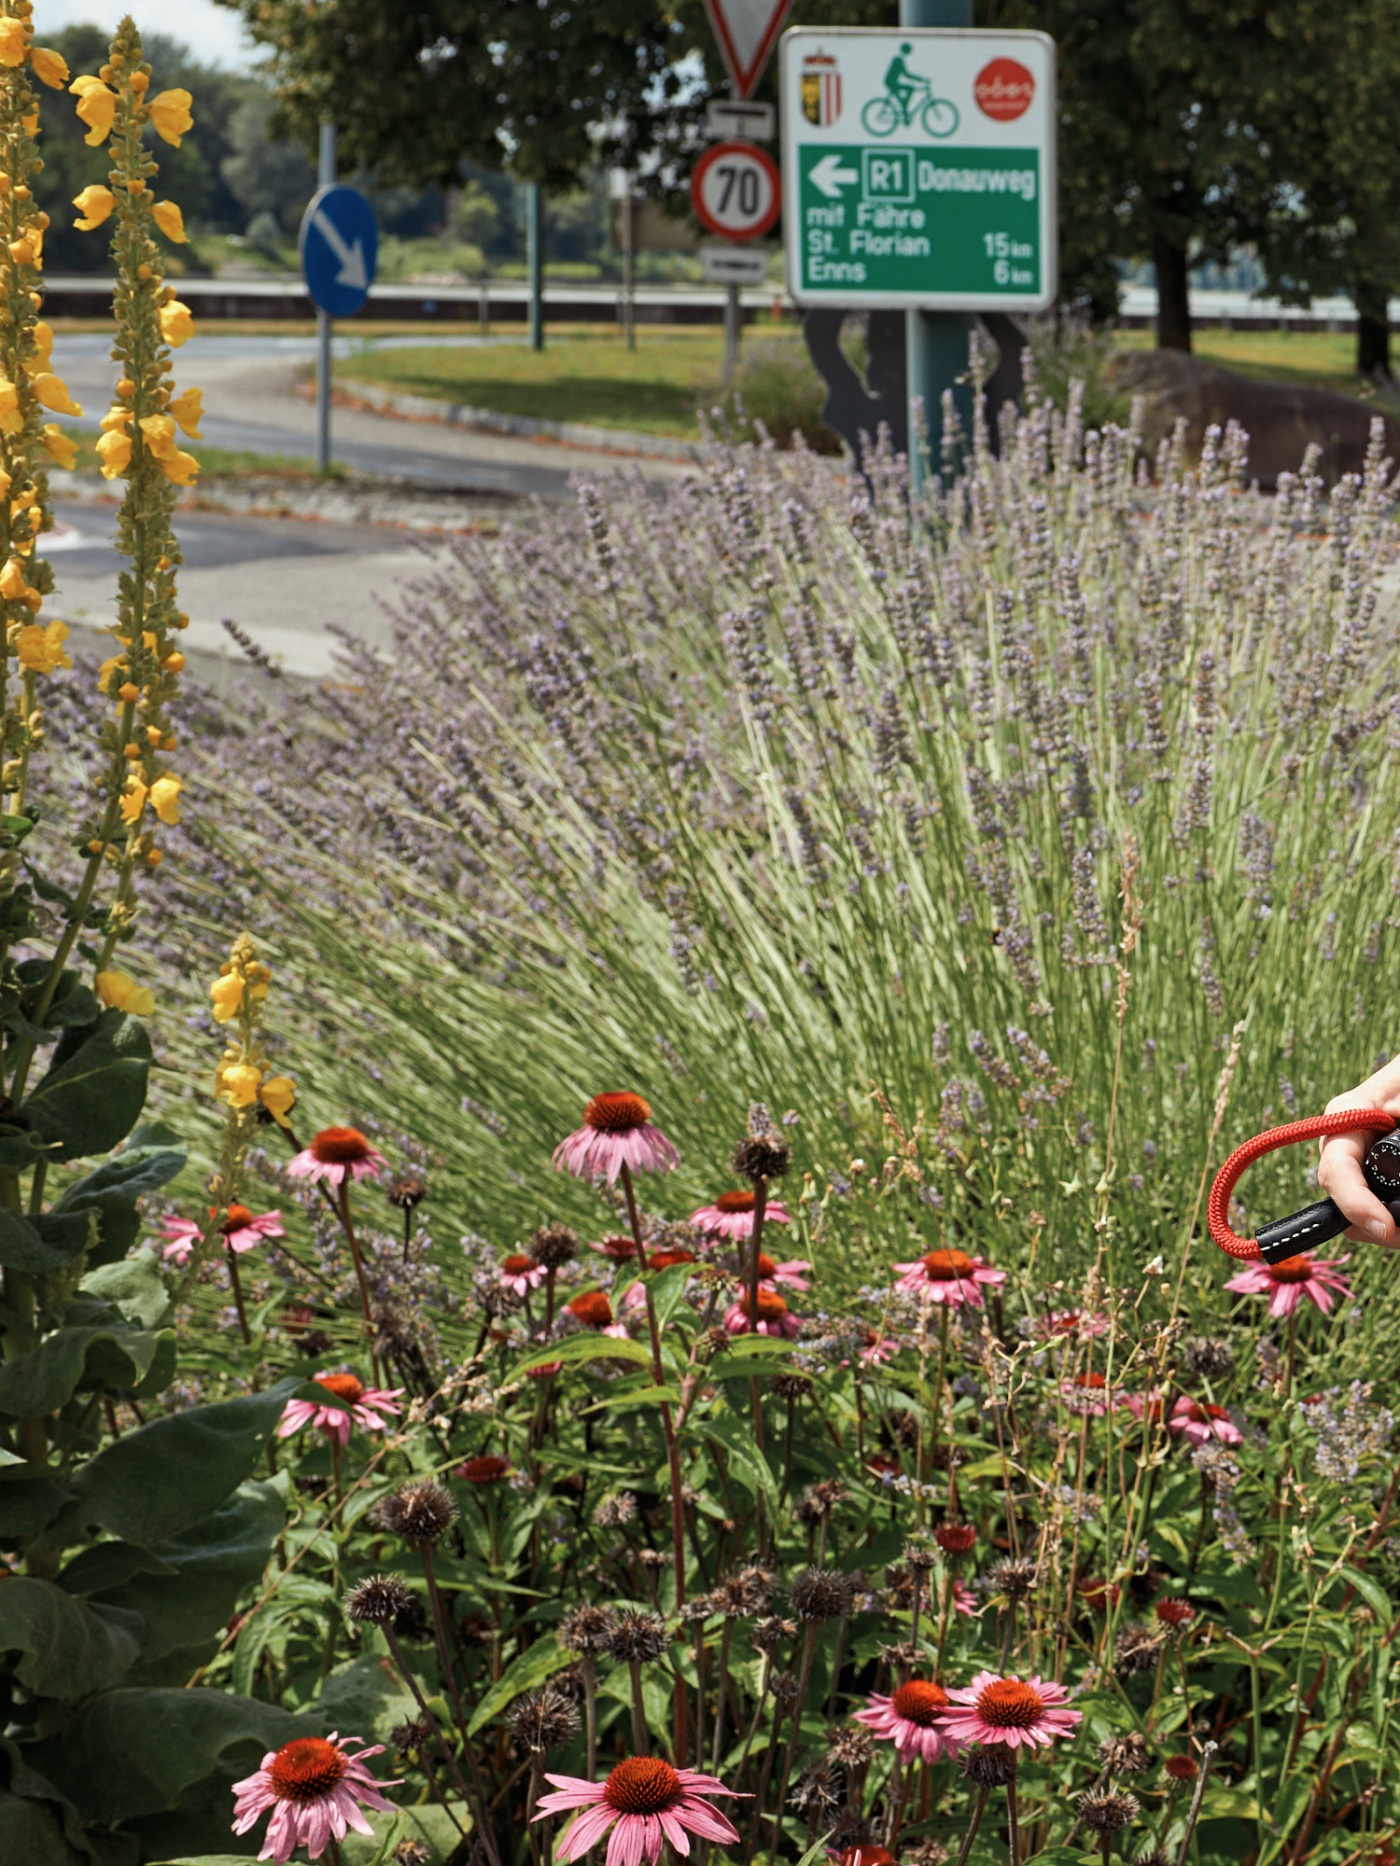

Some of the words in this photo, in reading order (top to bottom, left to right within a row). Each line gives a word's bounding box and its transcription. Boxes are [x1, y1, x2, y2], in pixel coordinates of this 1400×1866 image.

[717, 165, 759, 217] 70
[870, 160, 902, 191] R1
[918, 162, 1035, 200] Donauweg
[807, 203, 845, 228] mit
[857, 203, 926, 229] Fähre
[807, 230, 840, 255] St.
[850, 230, 930, 256] Florian
[984, 233, 1010, 258] 15
[1011, 241, 1033, 258] km
[808, 256, 867, 282] Enns
[994, 261, 1009, 284] 6
[1011, 268, 1033, 284] km
